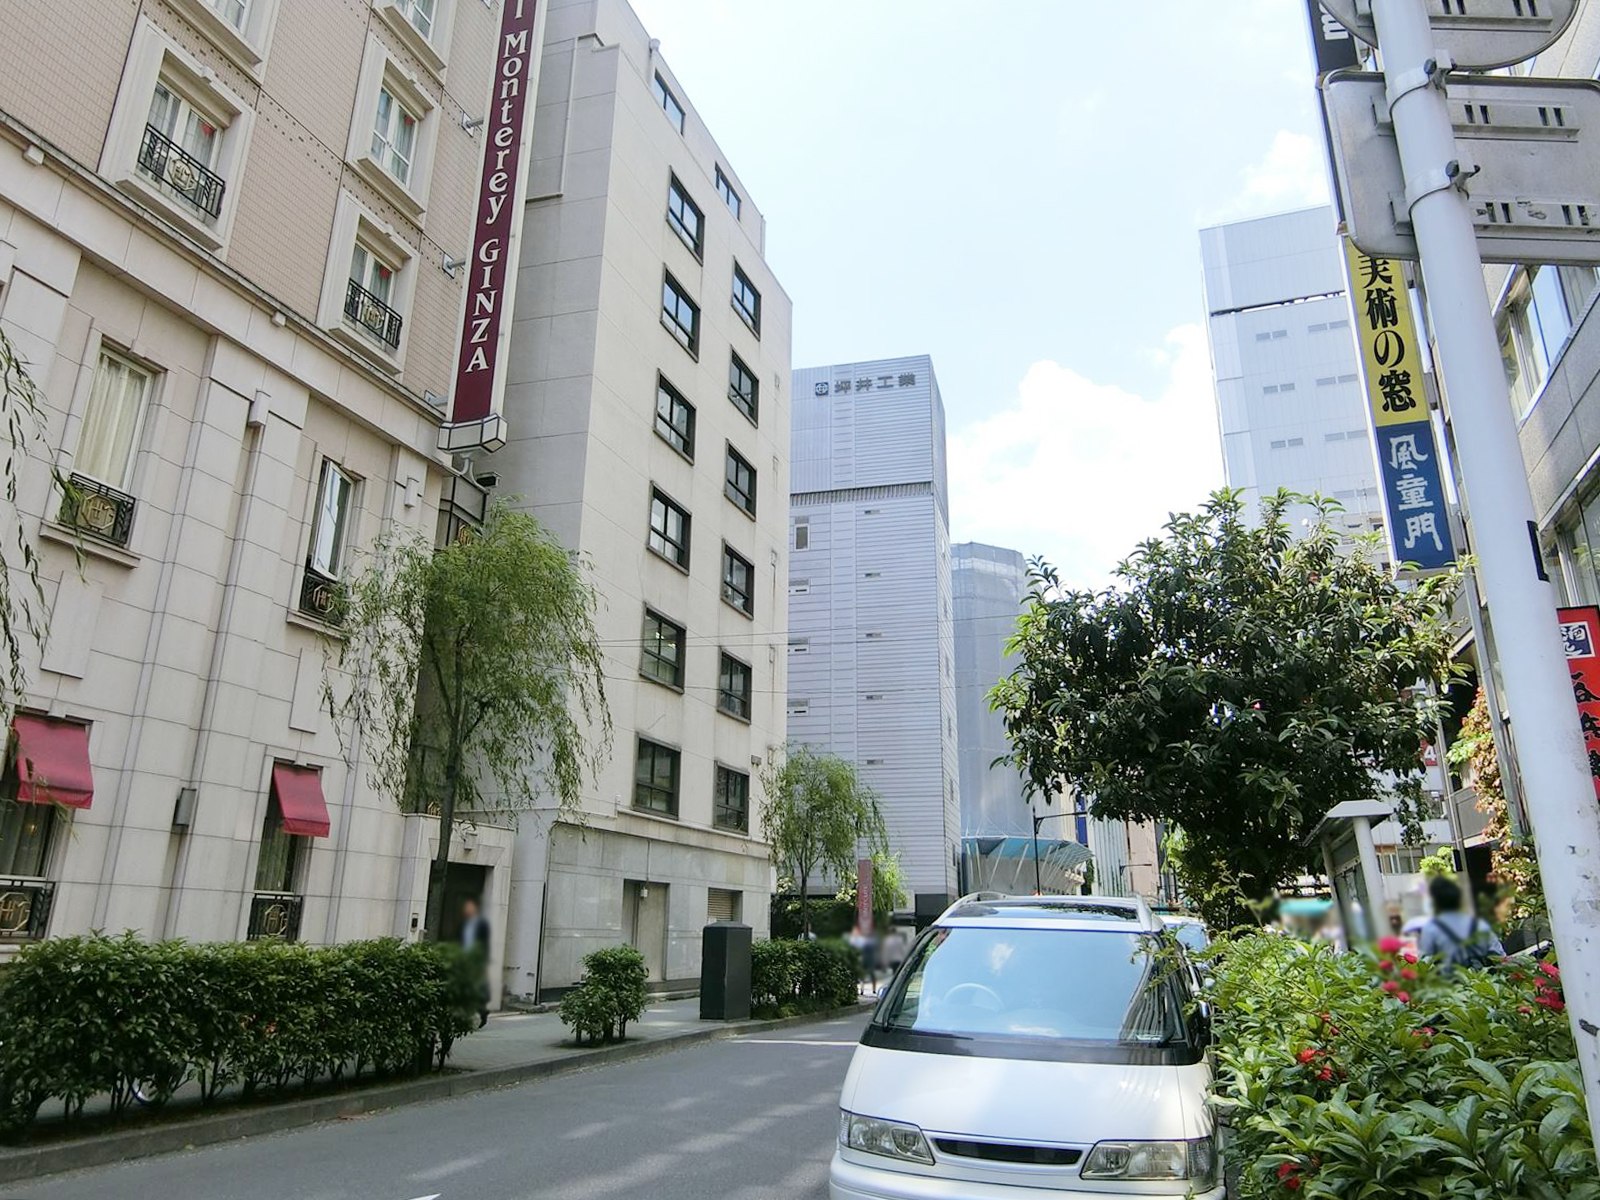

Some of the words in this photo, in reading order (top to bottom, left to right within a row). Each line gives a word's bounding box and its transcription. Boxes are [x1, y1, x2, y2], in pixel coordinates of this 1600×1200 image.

[486, 29, 528, 225] Monterey
[465, 238, 501, 373] GINZA
[1357, 254, 1417, 413] 美術の窓
[1388, 433, 1444, 552] 風童門
